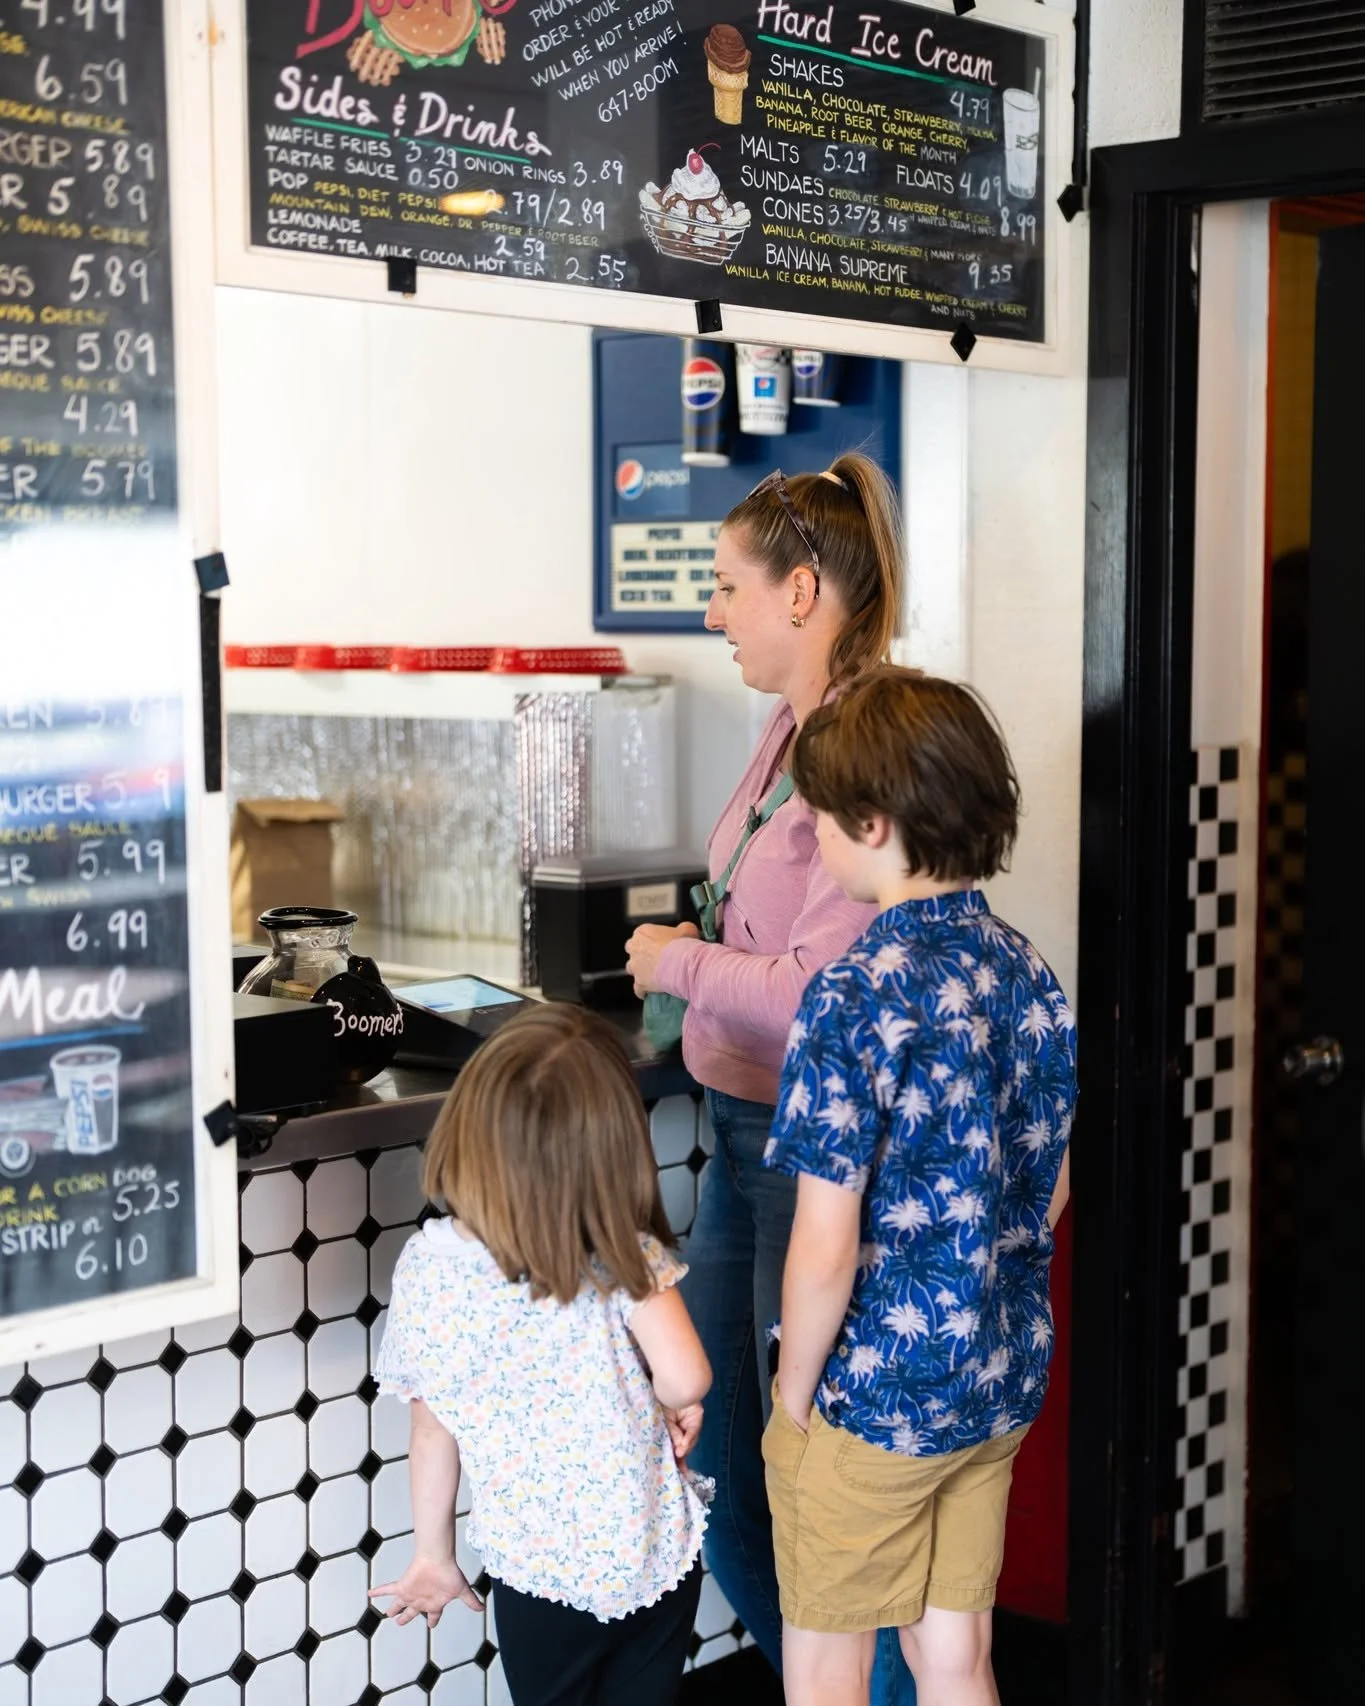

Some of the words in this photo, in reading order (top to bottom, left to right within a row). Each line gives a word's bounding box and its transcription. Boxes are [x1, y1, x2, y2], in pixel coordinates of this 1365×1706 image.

[523, 25, 572, 61] ORDER
[582, 0, 620, 27] YOUR
[531, 60, 571, 87] WILL
[572, 44, 593, 66] BE
[595, 24, 622, 52] HOT
[634, 0, 675, 27] READY
[757, 0, 834, 44] Hard
[851, 14, 901, 59] Ice
[915, 28, 998, 86] Cream
[35, 54, 128, 106] 6.59
[558, 69, 600, 100] WHEN
[603, 53, 630, 79] YOU
[598, 57, 679, 122] 647-BOOM
[769, 53, 844, 87] SHAKES
[949, 90, 990, 124] 4.79
[274, 65, 379, 126] Sides
[414, 91, 553, 156] Drinks
[761, 78, 817, 105] VANILLA,
[822, 92, 890, 121] CHOCOLATE,
[811, 106, 840, 123] ROOT
[264, 124, 336, 149] WAFFLE
[339, 135, 392, 158] FRIES
[404, 140, 457, 169] 3.29
[464, 156, 515, 177] ONION
[522, 165, 567, 185] RINGS
[574, 160, 624, 188] 3.89
[766, 114, 826, 138] PINEAPPLE
[840, 130, 879, 150] FLAVOR
[882, 139, 895, 151] OF
[899, 142, 917, 156] THE
[921, 145, 957, 165] MONTH
[263, 145, 337, 171] TARTAR
[344, 157, 399, 181] SAUCE
[408, 167, 459, 189] 0.50
[267, 168, 309, 190] POP
[357, 187, 390, 202] DIET
[741, 133, 800, 164] MALTS
[823, 144, 867, 173] 5.29
[896, 164, 955, 195] FLOATS
[960, 171, 1002, 207] 4.09
[740, 165, 824, 196] SUNDAES
[884, 196, 940, 215] STRAWBERRY
[763, 196, 824, 225] CONES
[267, 208, 362, 234] LEMONADE
[494, 235, 546, 261] 2.59
[269, 193, 350, 214] MOUNTAIN
[481, 220, 522, 236] PEPPER
[1000, 206, 1037, 246] 8.99
[474, 254, 507, 272] HOT
[765, 243, 833, 273] BANANA
[840, 256, 912, 286] SUPREME
[930, 249, 955, 262] MANY
[69, 253, 149, 305] 5.89
[725, 263, 770, 281] VANILLA
[776, 270, 790, 283] ICE
[874, 284, 892, 297] HOT
[930, 303, 950, 315] AND
[76, 328, 157, 376] 5.89
[63, 393, 139, 437] 4.29
[645, 469, 690, 491] pepsi
[77, 838, 166, 885] 5.99
[66, 908, 148, 952] 6.99
[0, 965, 146, 1035] Meal
[28, 1181, 45, 1201] A
[53, 1172, 107, 1198] CORN
[113, 1163, 157, 1187] DOG
[112, 1180, 180, 1222] 5.25
[1, 1219, 75, 1256] STRIP
[75, 1233, 148, 1281] 6.10
